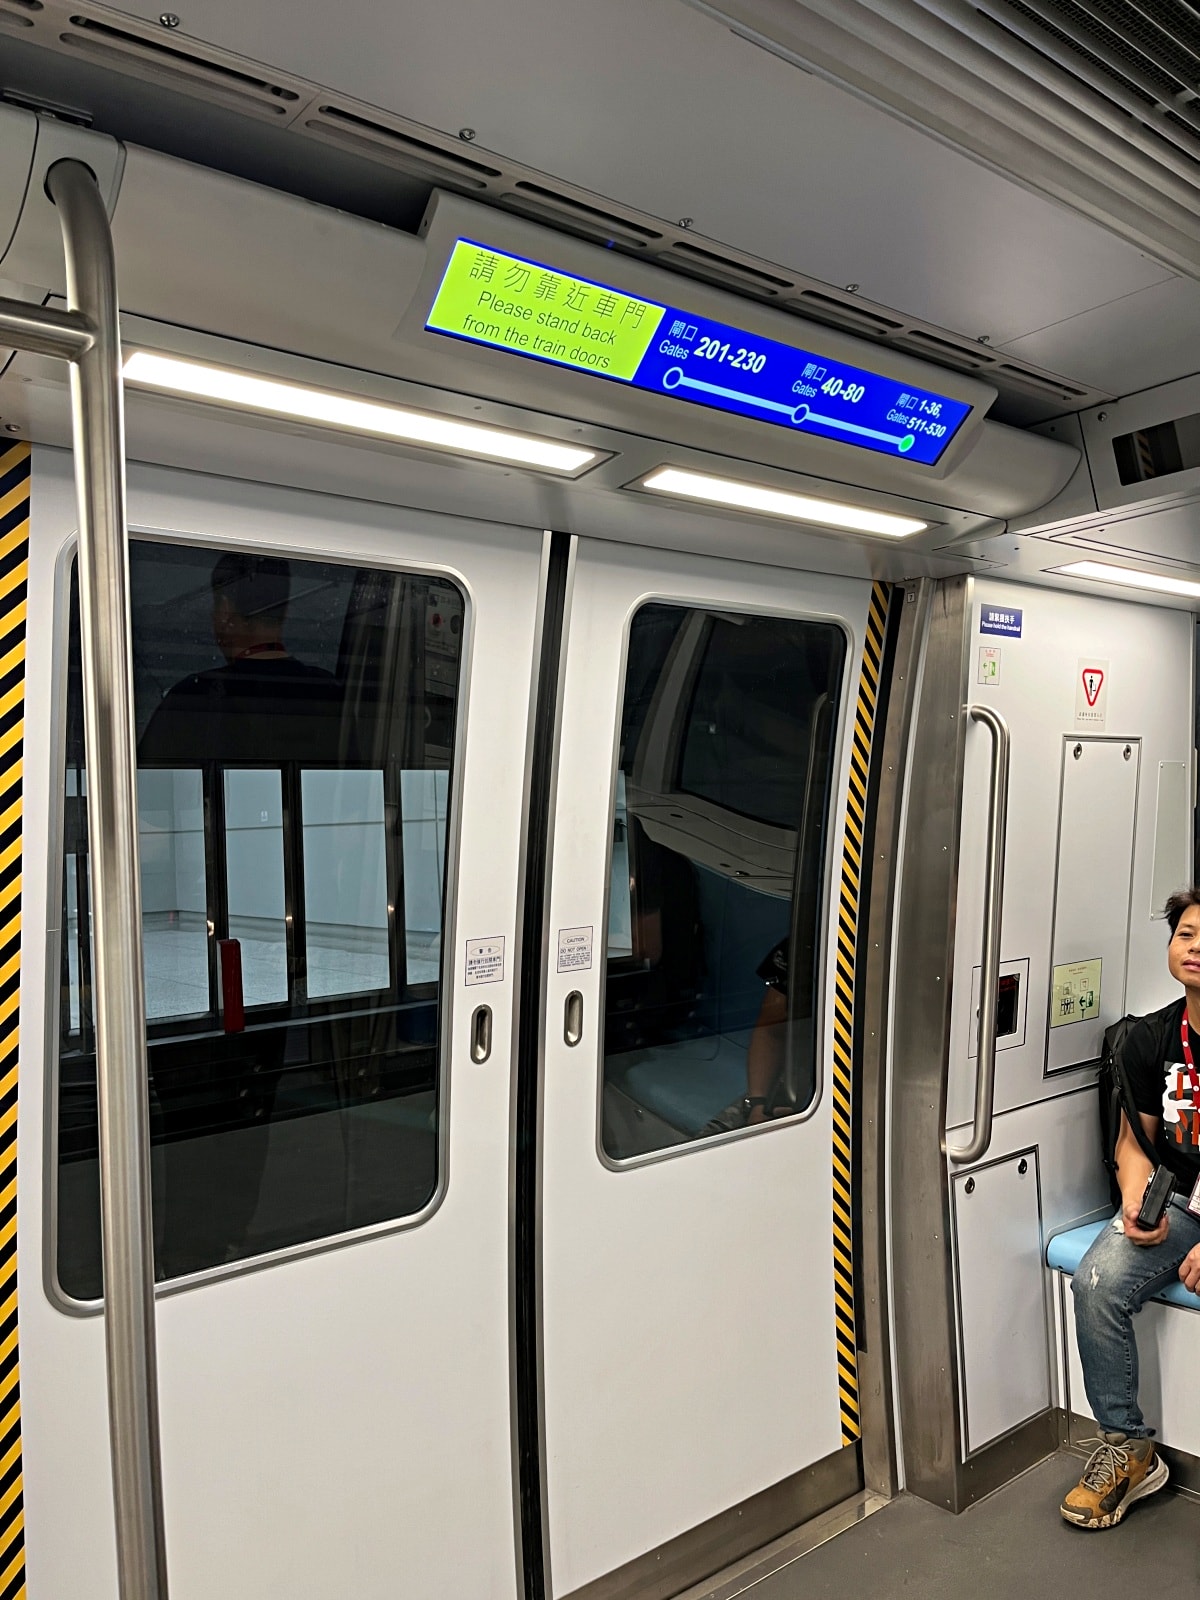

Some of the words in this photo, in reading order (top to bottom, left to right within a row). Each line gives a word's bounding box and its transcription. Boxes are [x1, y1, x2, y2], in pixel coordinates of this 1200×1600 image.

[469, 251, 647, 329] 請勿靠近車門
[476, 290, 533, 321] Please
[536, 311, 583, 337] stand
[581, 322, 618, 345] back
[668, 320, 698, 342] 閘口
[462, 314, 501, 339] from
[504, 326, 529, 346] the
[532, 335, 567, 357] train
[569, 345, 611, 369] doors
[659, 339, 690, 360] Gates
[693, 336, 767, 373] 201-230
[801, 362, 827, 382] 閘口
[791, 380, 818, 398] Gates
[821, 377, 865, 403] 40-80
[886, 408, 910, 425] Gates
[906, 416, 947, 438] 511-530
[919, 399, 943, 419] 1-36,
